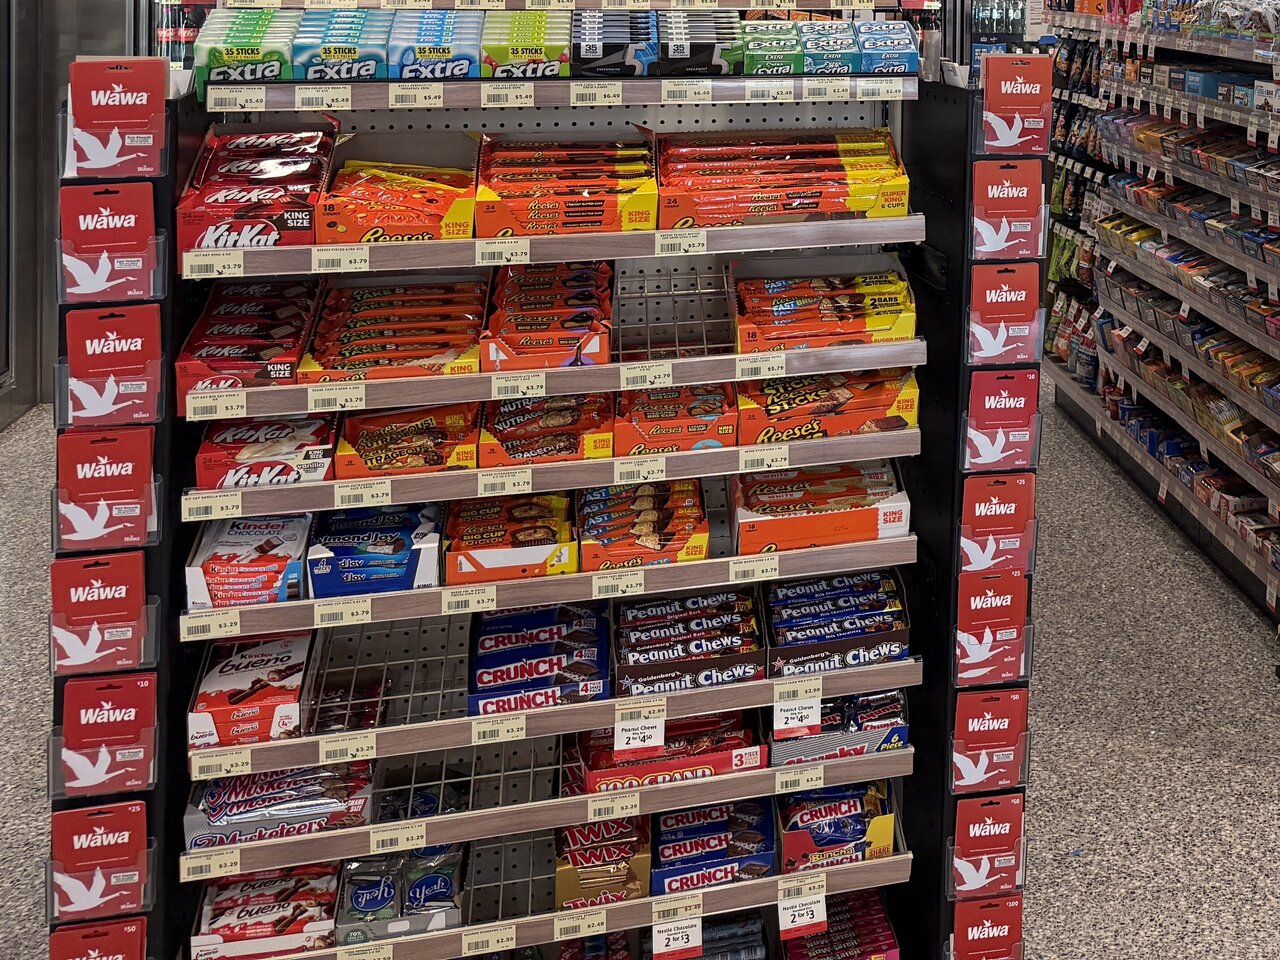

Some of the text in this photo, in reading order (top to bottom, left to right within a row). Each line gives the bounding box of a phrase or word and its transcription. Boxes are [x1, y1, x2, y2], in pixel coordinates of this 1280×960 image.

[225, 47, 261, 56] 35 STICKS
[322, 47, 356, 56] 35 STICKS
[418, 46, 451, 56] 35 STICKS
[210, 60, 280, 79] Extra
[306, 60, 376, 79] Extra
[402, 60, 469, 79] Extra
[494, 59, 560, 78] Extra
[1001, 81, 1040, 94] Wawa
[91, 90, 148, 106] Wawa
[205, 189, 285, 204] KitKat
[751, 192, 781, 201] Reese's
[988, 184, 1027, 199] Wawa
[528, 200, 559, 210] Reese's
[79, 214, 135, 230] Wawa
[528, 210, 559, 220] Reese's
[445, 222, 469, 230] KING
[202, 224, 279, 248] KitKat
[86, 338, 142, 354] Wawa
[270, 370, 290, 378] SIZE
[214, 424, 295, 443] KitKat
[649, 425, 683, 435] Reese's
[757, 420, 820, 443] Reese's
[77, 462, 133, 478] Wawa
[222, 468, 301, 488] KitKat
[229, 520, 288, 532] Kinder
[883, 516, 903, 524] SIZE
[463, 532, 504, 541] BIG CUP
[70, 587, 127, 601] Wawa
[480, 625, 563, 650] CRUNCH
[628, 637, 742, 664] Peanut Chews
[219, 655, 291, 674] bueno
[783, 643, 900, 675] Peanut Chews
[477, 657, 563, 684] CRUNCH
[632, 665, 755, 694] Peanut Chews
[482, 689, 557, 714] CRUNCH
[80, 708, 136, 724] Wawa
[231, 724, 258, 733] bueno
[881, 740, 903, 750] Piece
[662, 806, 730, 829] CRUNCH
[800, 800, 858, 824] CRUNCH
[228, 819, 327, 842] Musketeers
[73, 831, 129, 849] Wawa
[660, 834, 730, 860] CRUNCH
[566, 845, 634, 866] TWIX
[810, 847, 854, 862] Buncha
[666, 865, 737, 891] CRUNCH
[236, 901, 290, 919] bueno
[799, 899, 820, 908] Chocolate
[791, 914, 796, 923] 2
[806, 910, 814, 919] $3
[665, 938, 670, 947] 2
[681, 934, 689, 943] $3
